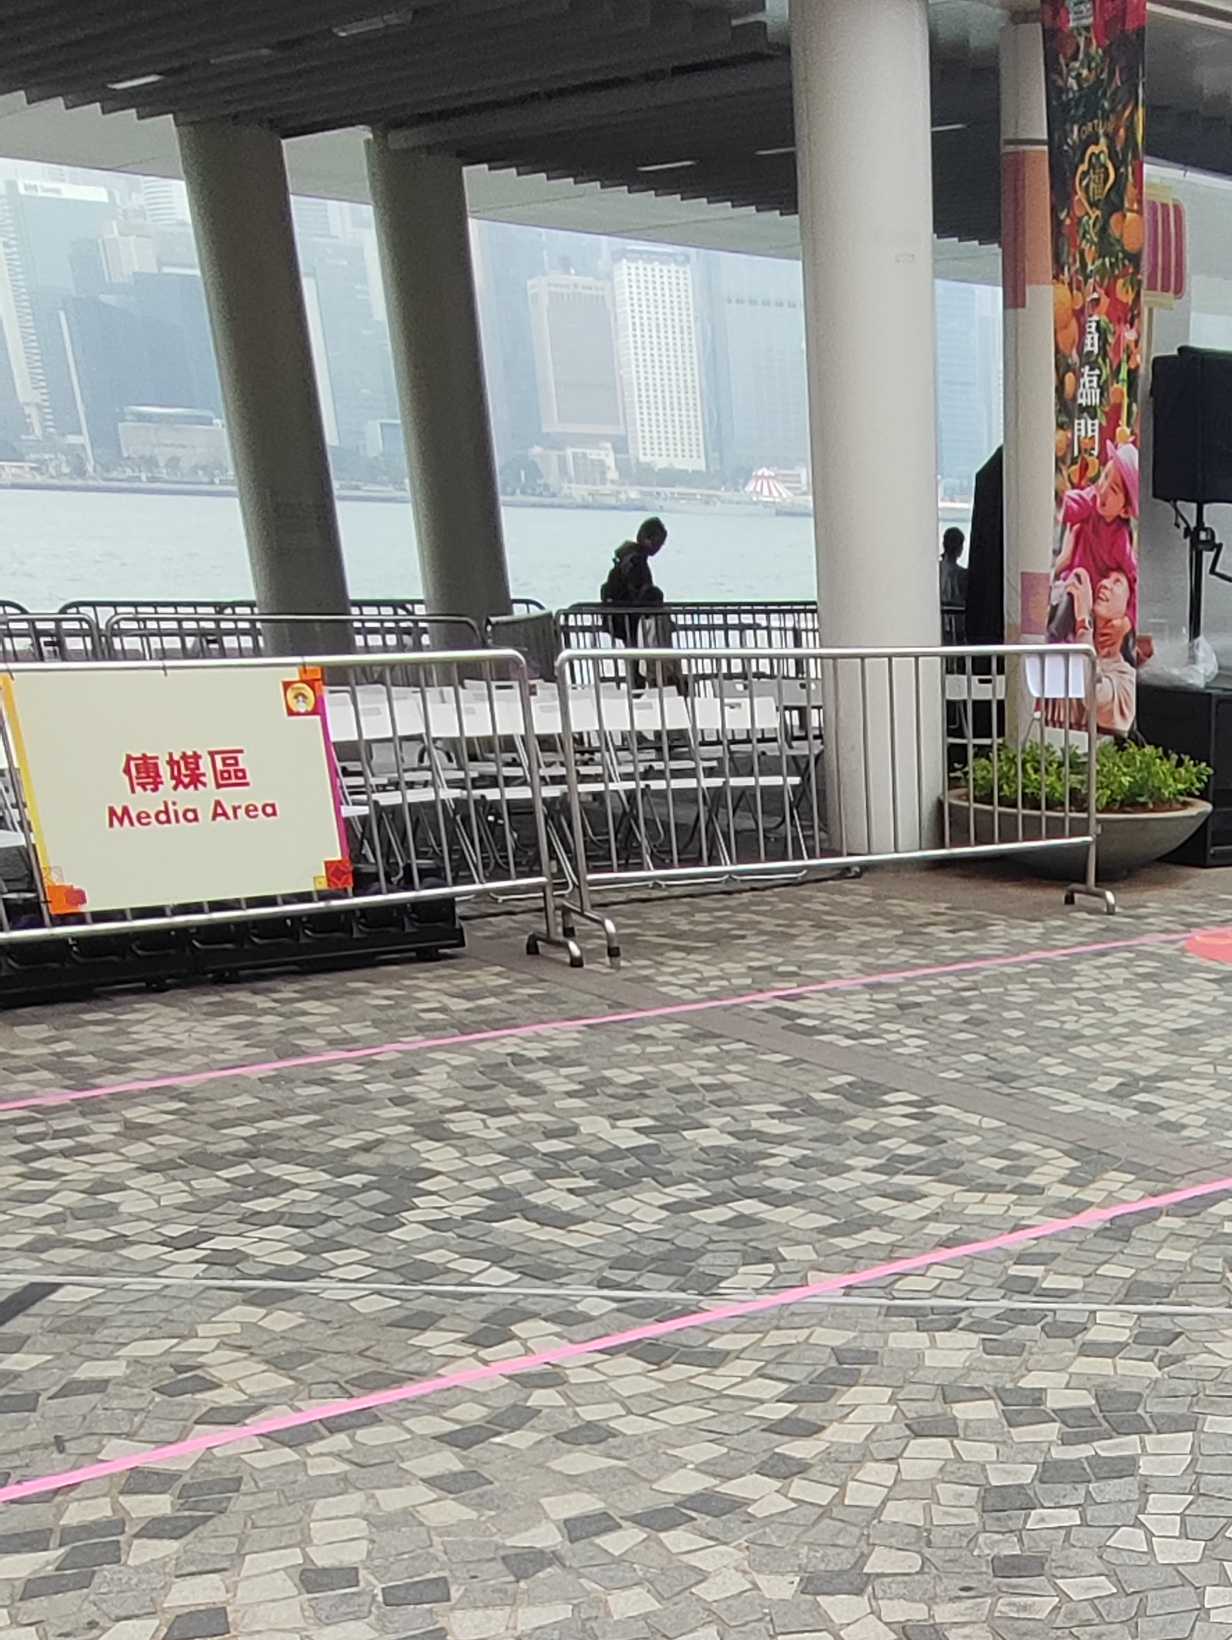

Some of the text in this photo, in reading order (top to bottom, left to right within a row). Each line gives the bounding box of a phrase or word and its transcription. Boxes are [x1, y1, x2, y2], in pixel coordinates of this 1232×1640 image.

[122, 748, 251, 794] 傳媒區
[107, 799, 279, 828] Media Area
